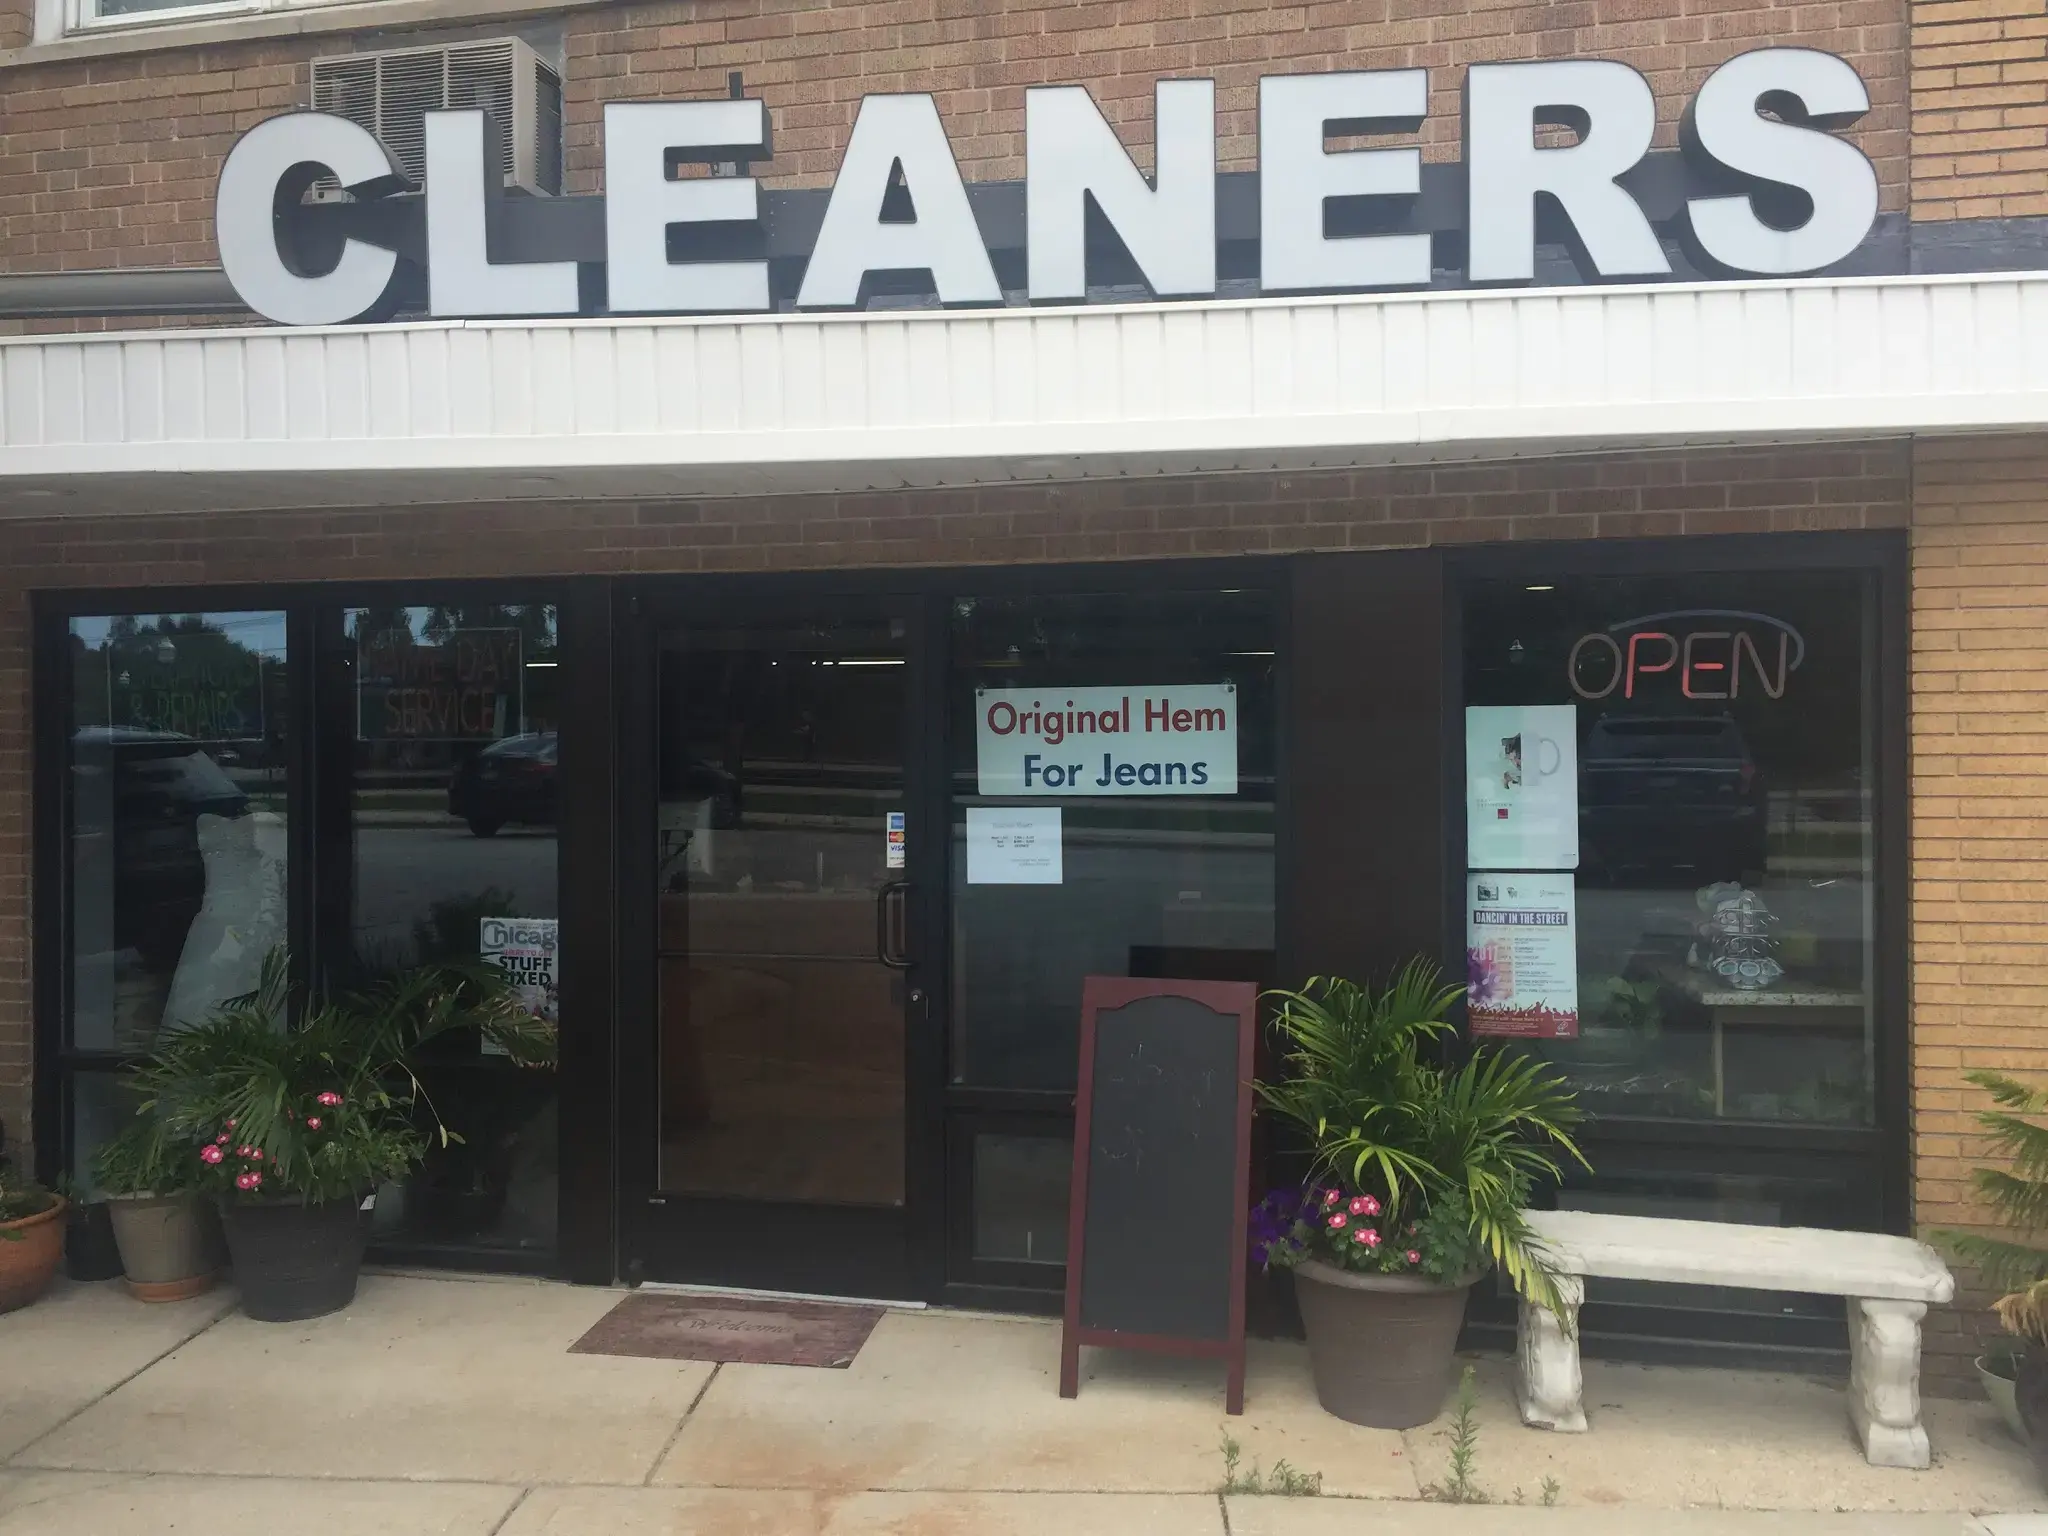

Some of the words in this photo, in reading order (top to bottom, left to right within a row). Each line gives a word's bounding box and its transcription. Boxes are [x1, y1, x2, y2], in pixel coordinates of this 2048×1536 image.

[216, 46, 1880, 326] CLEANERS
[1568, 631, 1789, 700] OPEN
[384, 686, 496, 734] SERVICE
[987, 696, 1130, 745] Original
[1144, 698, 1227, 733] Hem
[1023, 753, 1084, 788] For
[1095, 752, 1209, 787] Jeans
[890, 844, 906, 852] VISA
[1475, 911, 1508, 924] DANCIN'
[1508, 912, 1518, 924] IN
[1519, 912, 1535, 925] THE
[1536, 913, 1566, 925] STREET
[482, 921, 558, 950] Chicag
[499, 956, 553, 972] STUFF
[674, 1317, 794, 1334] Welcome
